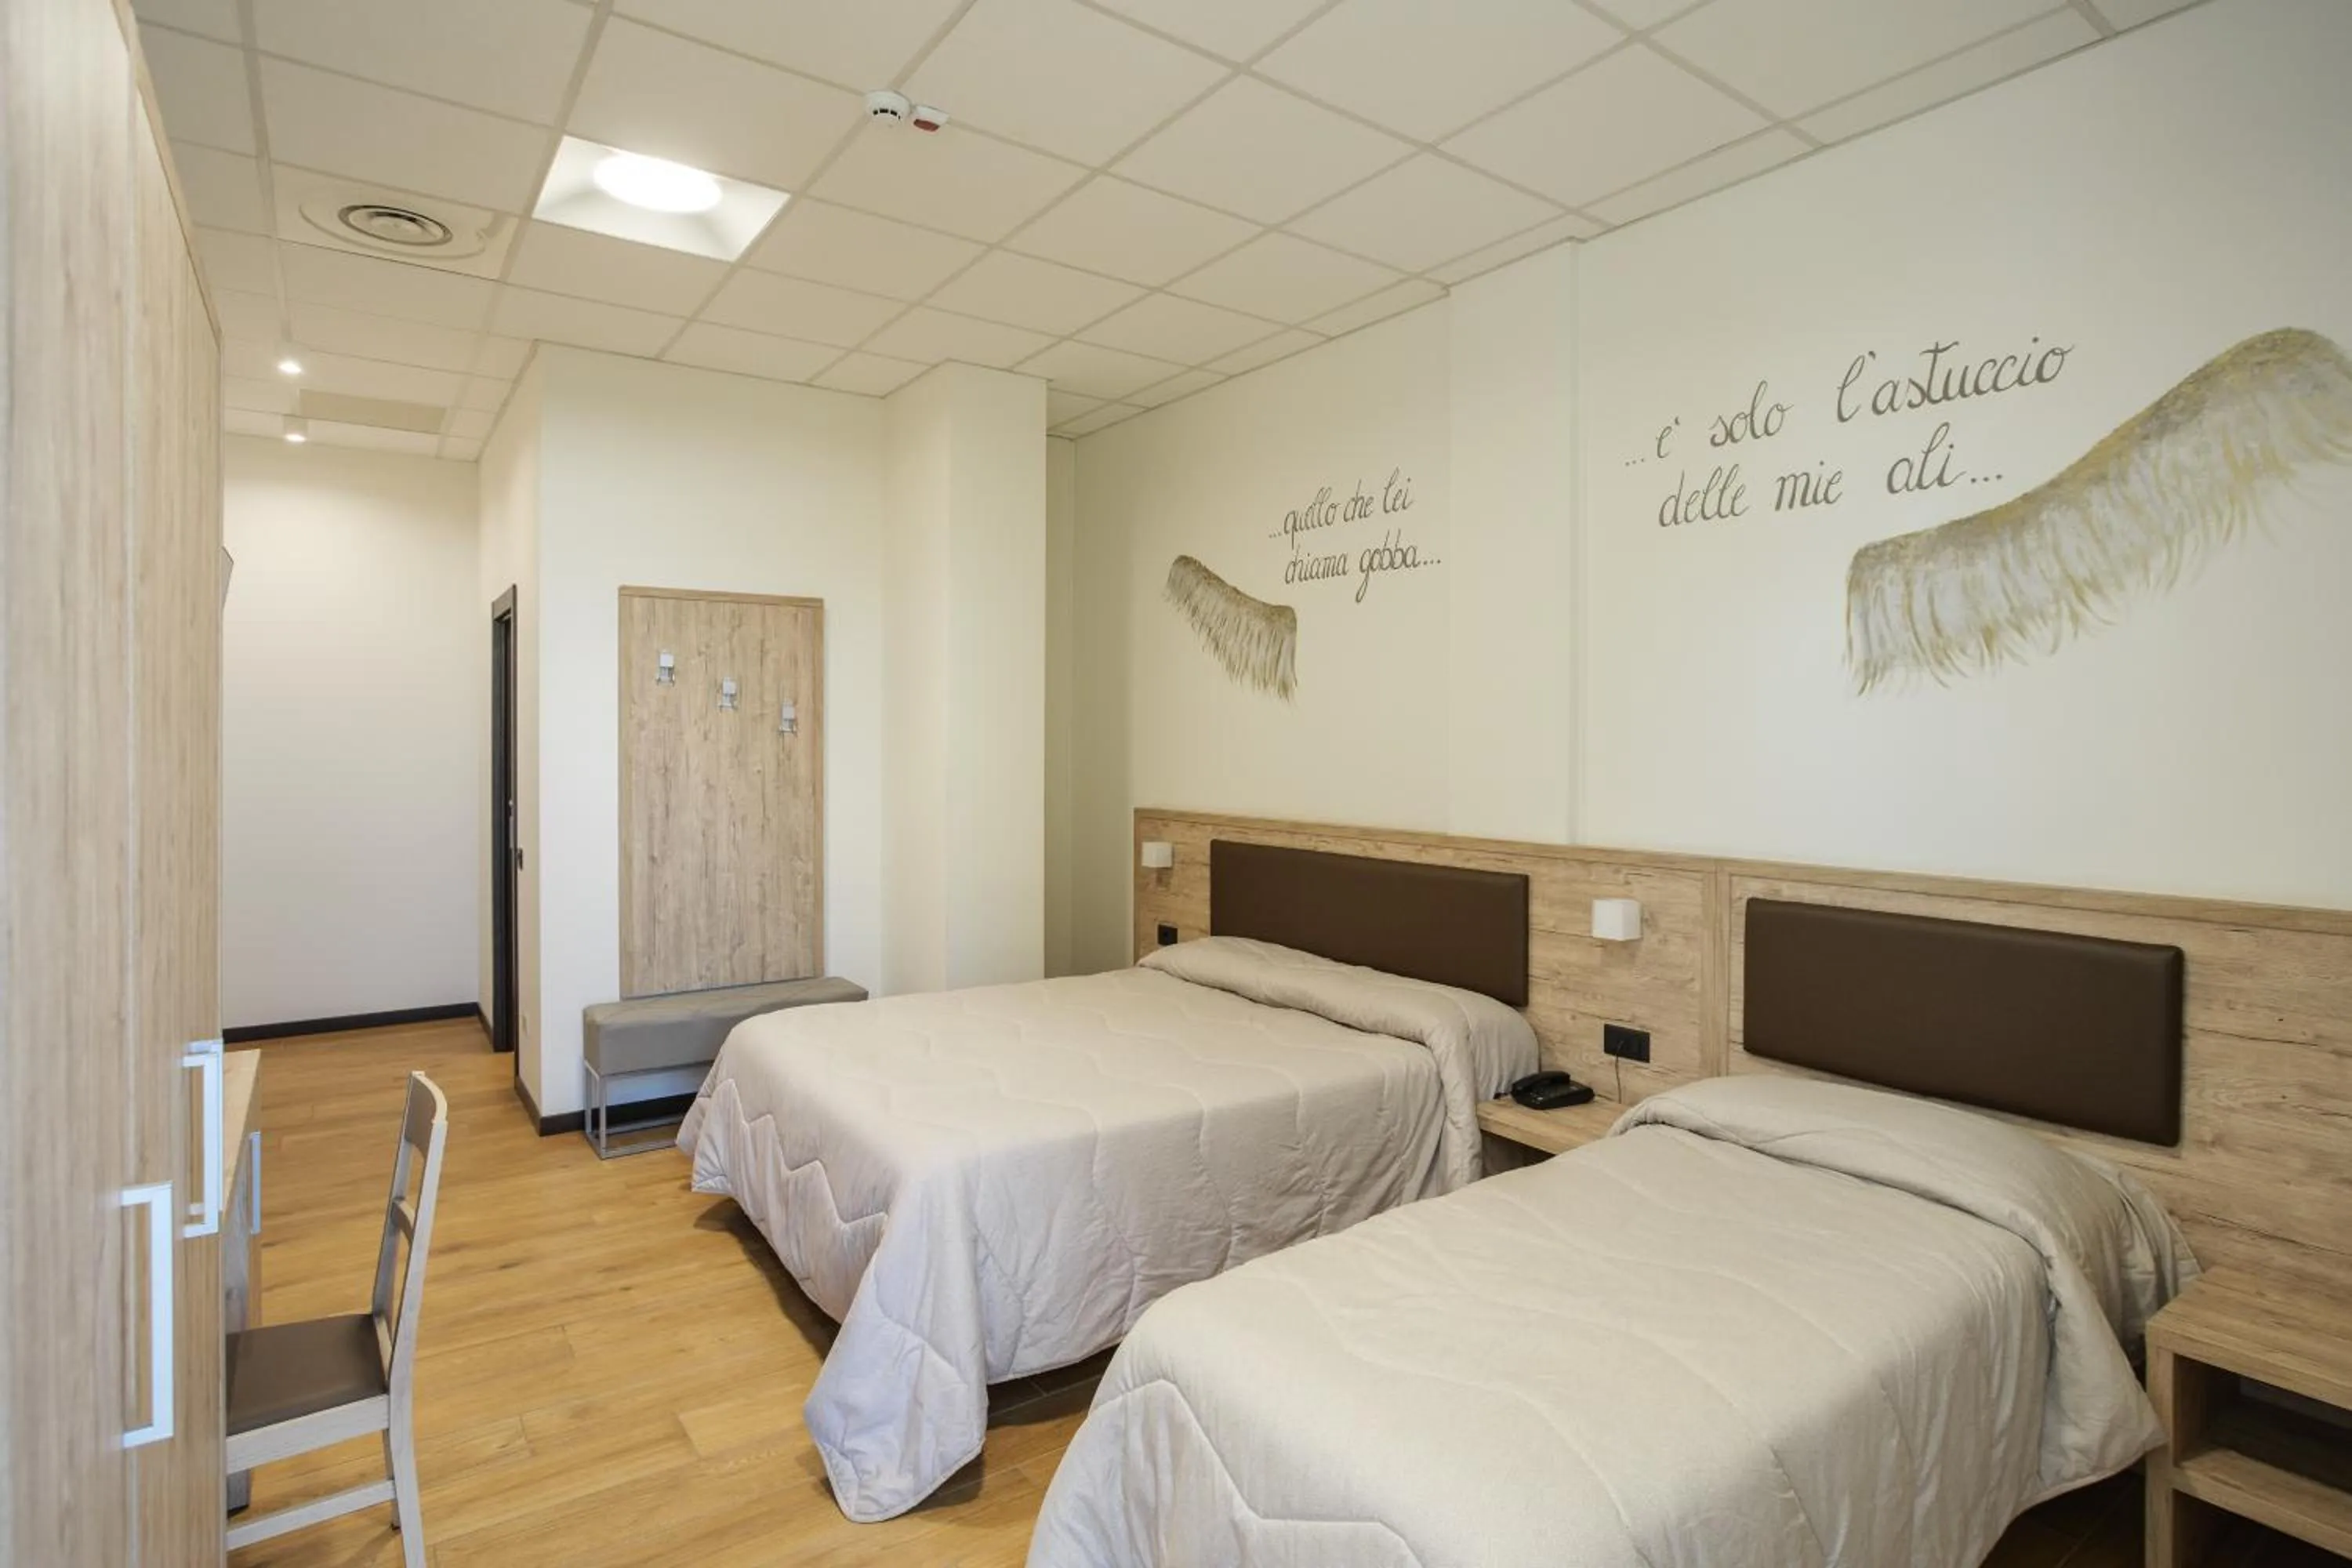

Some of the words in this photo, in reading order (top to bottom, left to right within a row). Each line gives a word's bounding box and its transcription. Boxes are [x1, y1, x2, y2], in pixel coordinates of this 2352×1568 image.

[1710, 381, 1793, 447] solo
[1838, 337, 2074, 423] l'astuccio
[1343, 479, 1374, 522] che
[1382, 466, 1414, 514] lei
[1658, 463, 1749, 528] delle
[1775, 460, 1843, 510] mie
[1285, 543, 1348, 585] chiama
